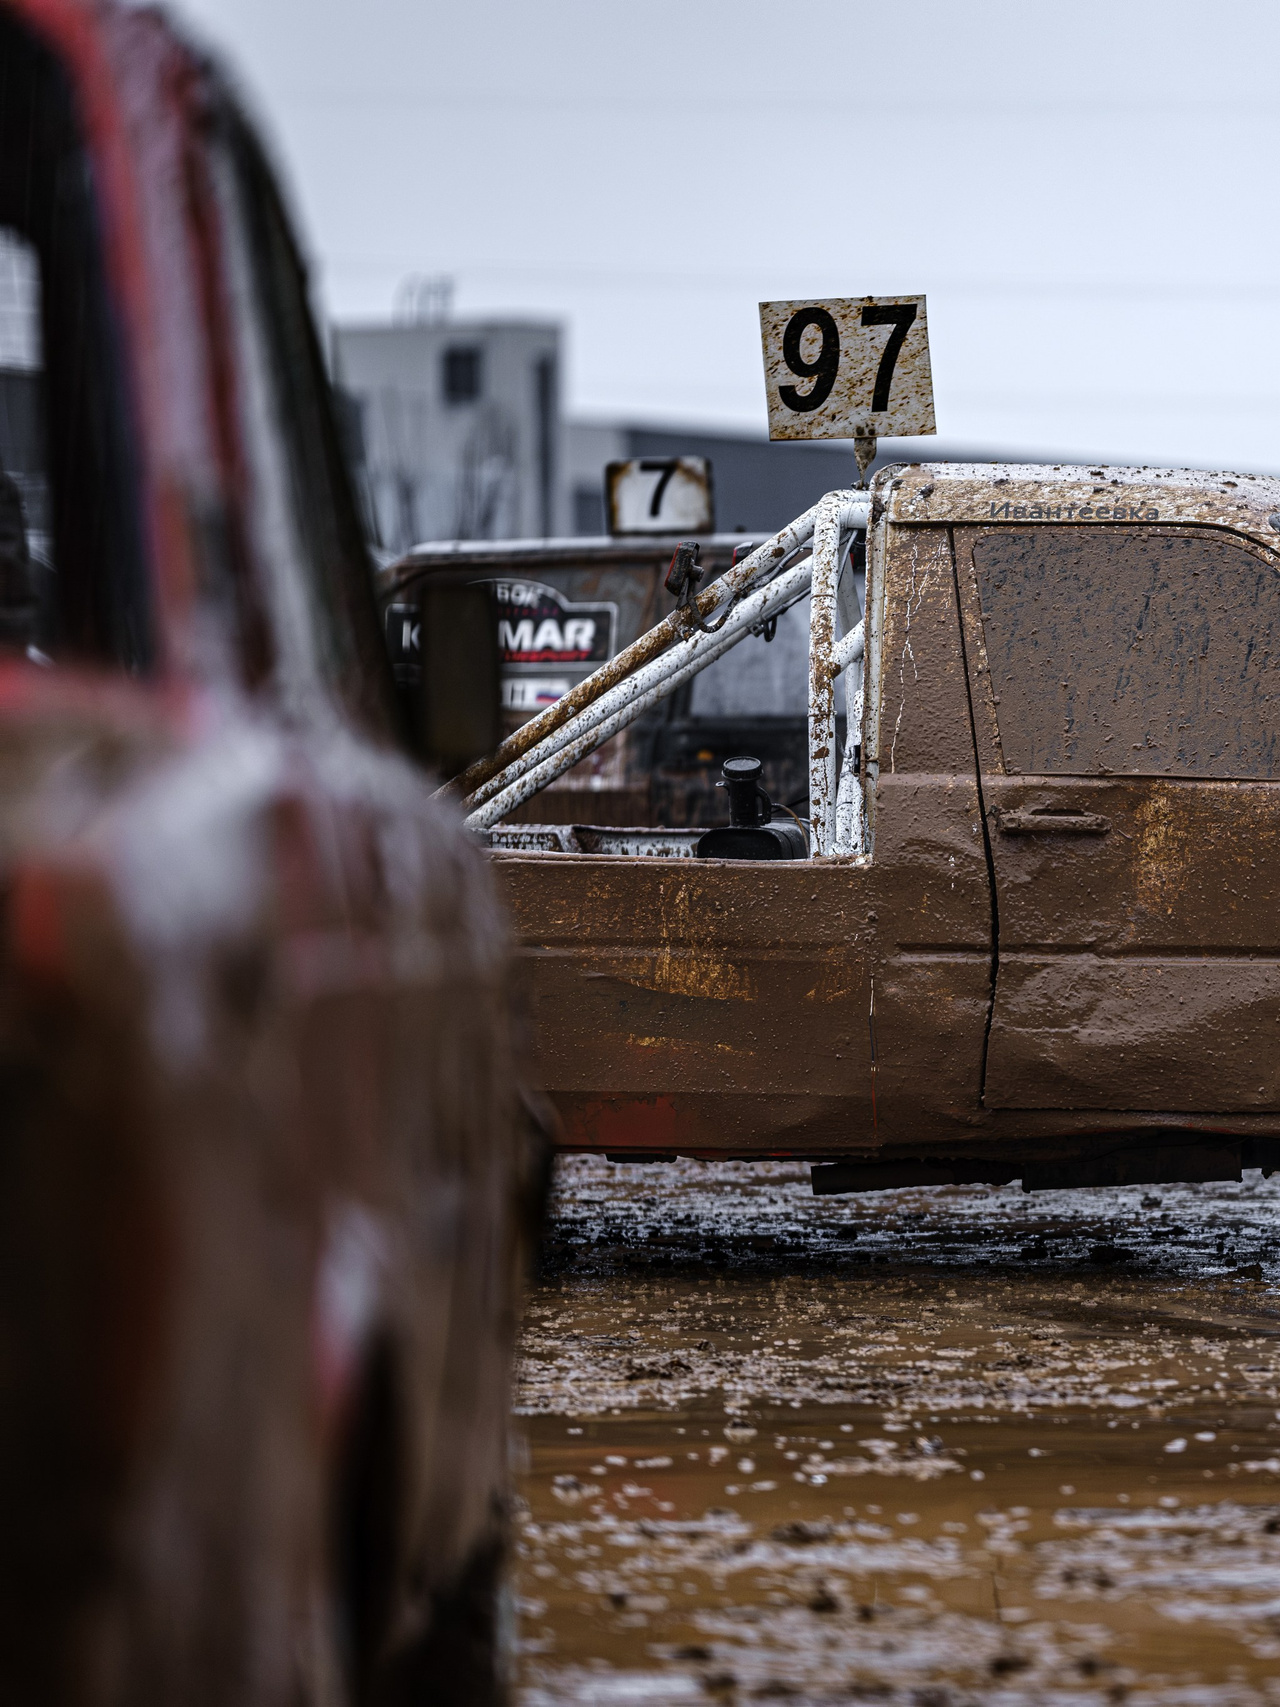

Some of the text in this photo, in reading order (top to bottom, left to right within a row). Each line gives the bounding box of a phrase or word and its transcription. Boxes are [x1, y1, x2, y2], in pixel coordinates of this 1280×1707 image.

[779, 304, 917, 413] 97
[640, 460, 679, 518] 7
[989, 501, 1159, 521] Ивантеевка
[402, 618, 597, 652] KMAR
